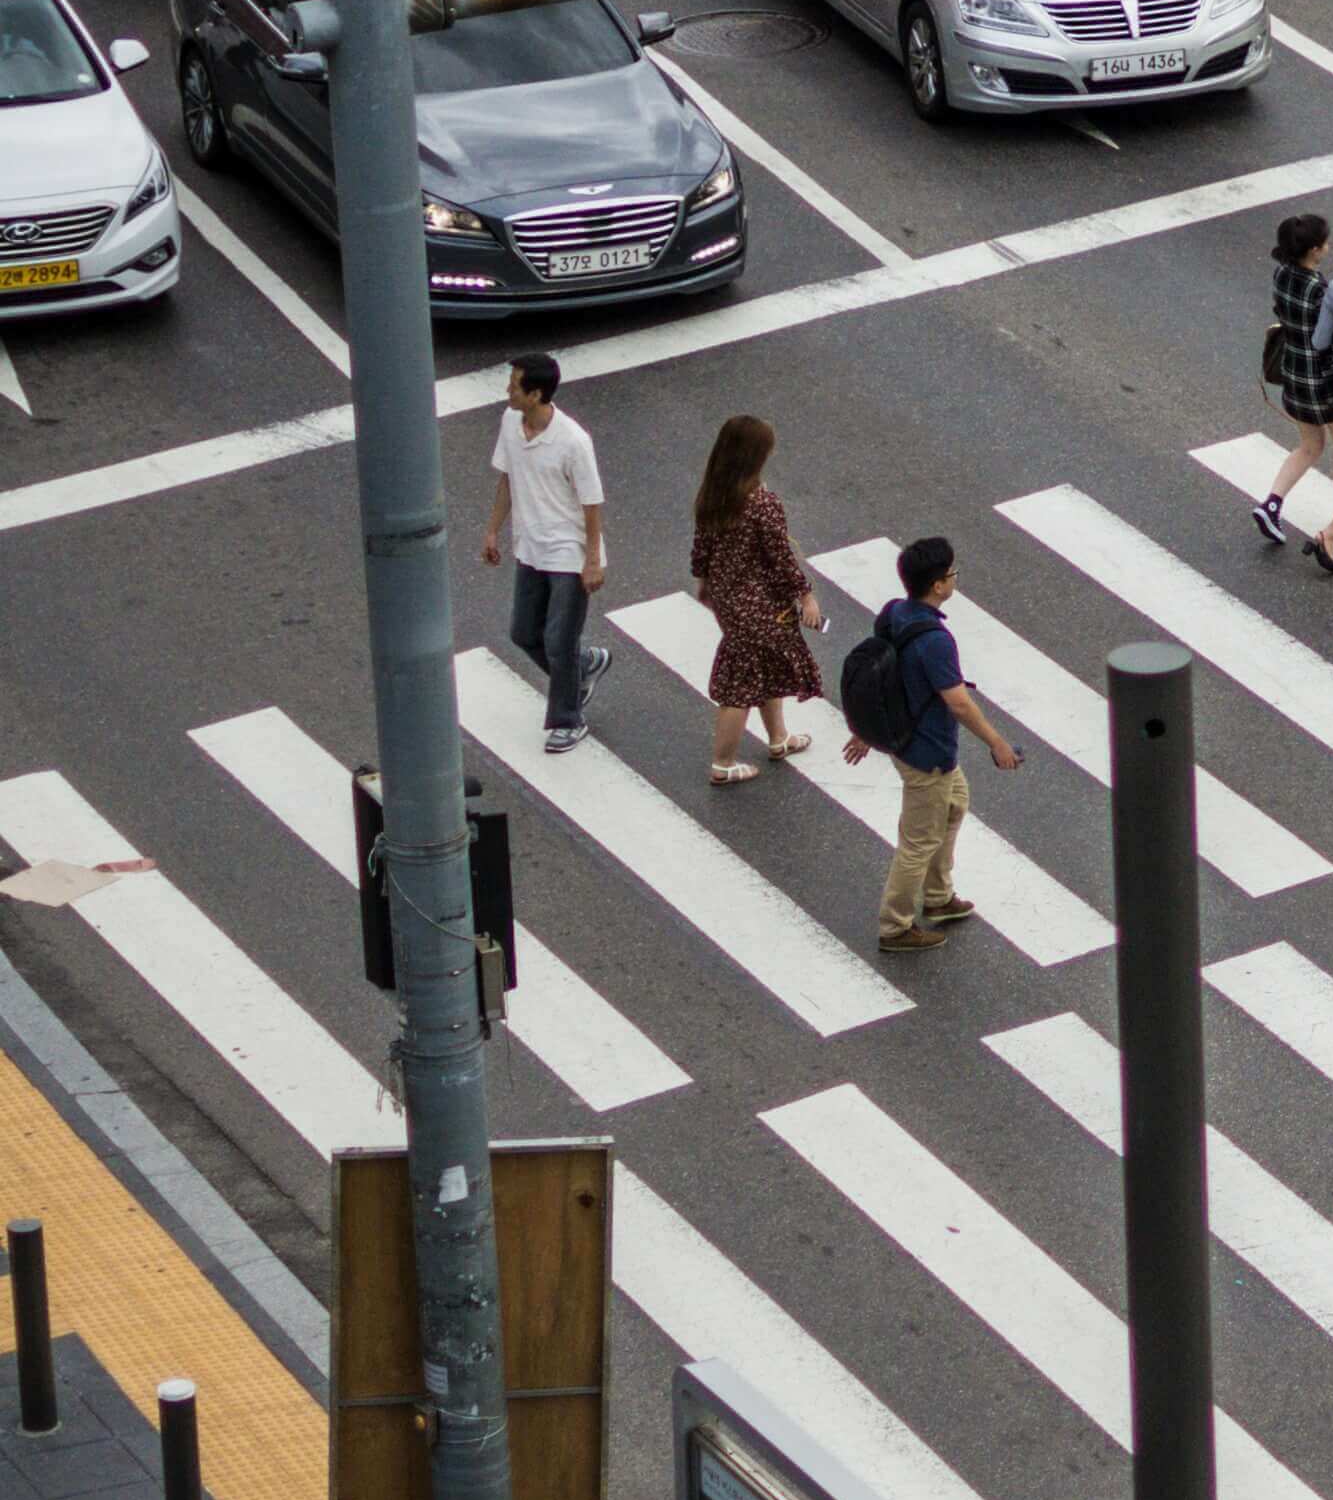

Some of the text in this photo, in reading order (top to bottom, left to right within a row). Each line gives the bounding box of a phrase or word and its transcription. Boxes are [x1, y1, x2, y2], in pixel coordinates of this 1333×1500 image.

[1139, 52, 1176, 71] 1436
[599, 248, 640, 268] 0121
[29, 263, 71, 282] 2894
